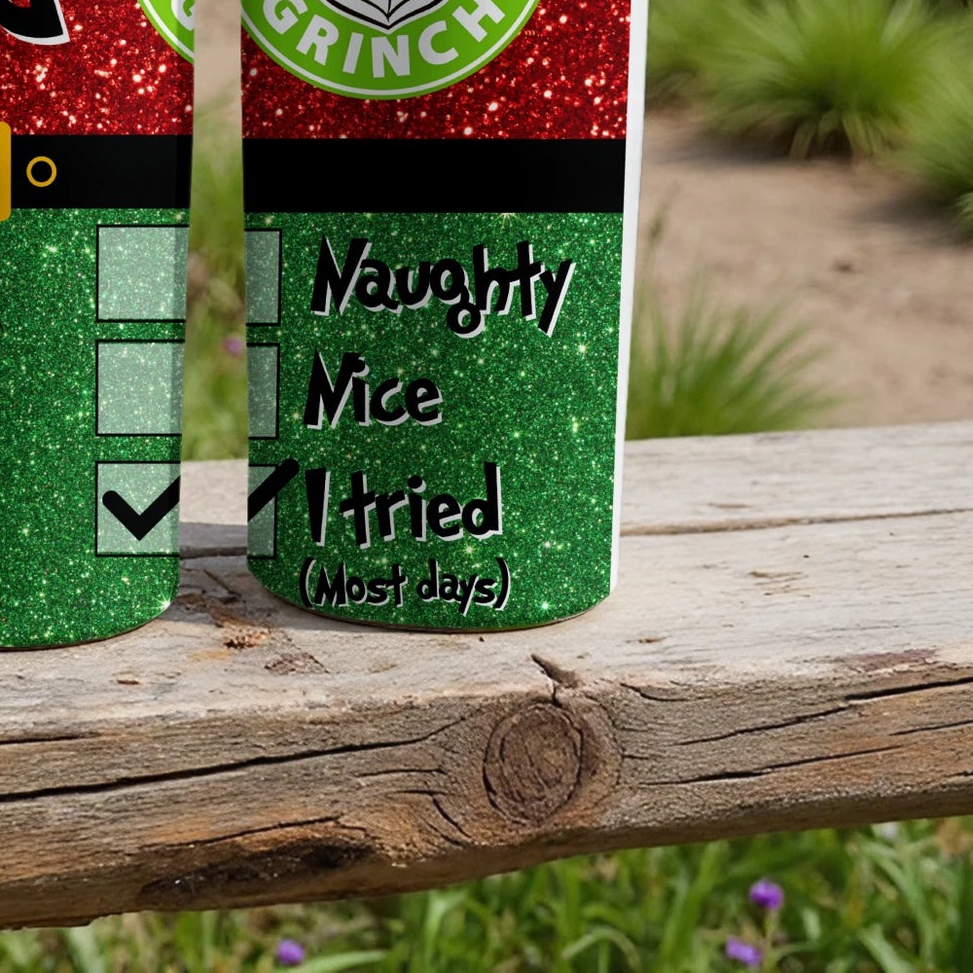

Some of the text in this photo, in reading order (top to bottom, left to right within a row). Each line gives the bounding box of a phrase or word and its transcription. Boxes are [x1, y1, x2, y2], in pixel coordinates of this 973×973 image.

[311, 234, 576, 338] Naughty
[303, 347, 443, 430] Nice
[305, 462, 503, 549] I tried
[299, 557, 511, 617] (Most days)
